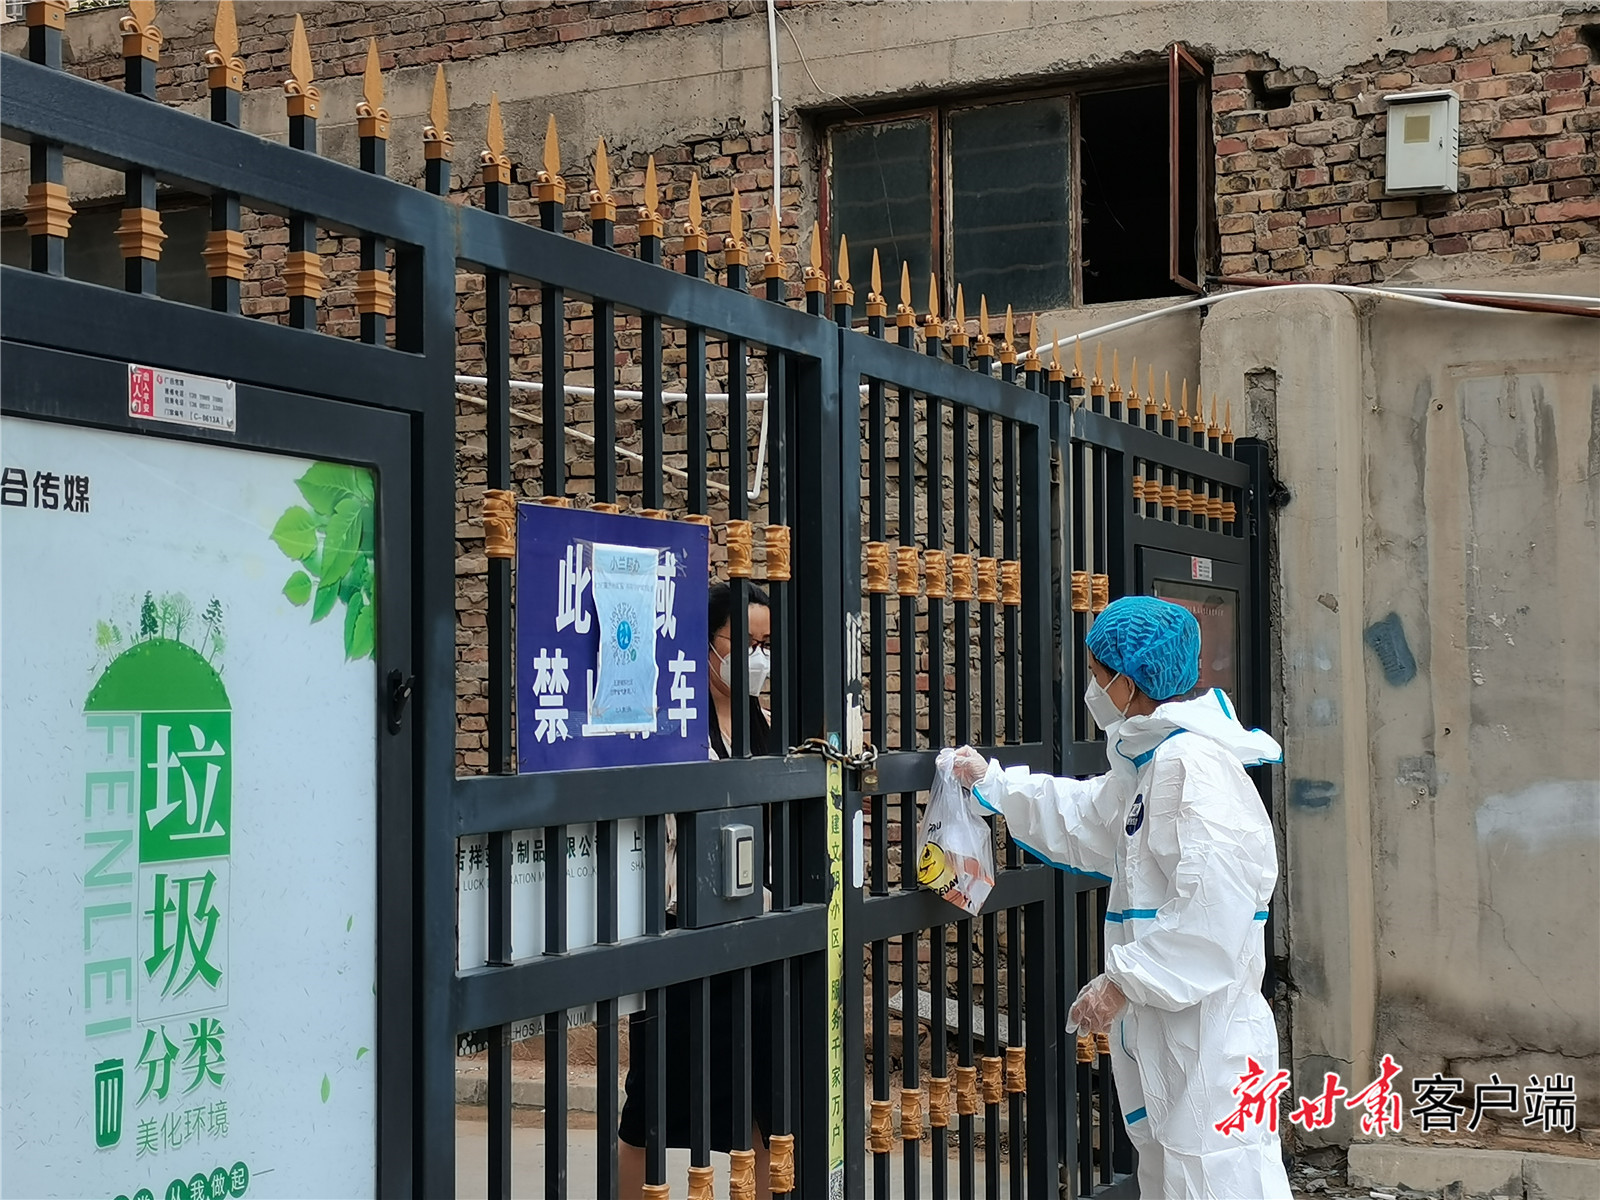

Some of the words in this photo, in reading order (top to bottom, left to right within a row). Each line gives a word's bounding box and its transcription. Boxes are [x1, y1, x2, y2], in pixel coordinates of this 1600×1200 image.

[0, 467, 90, 513] 合传媒
[556, 543, 677, 640] 此域
[84, 715, 135, 1037] FENLEI
[463, 878, 484, 892] LUCK
[134, 1017, 226, 1107] 分类
[135, 1099, 229, 1157] 美化环境
